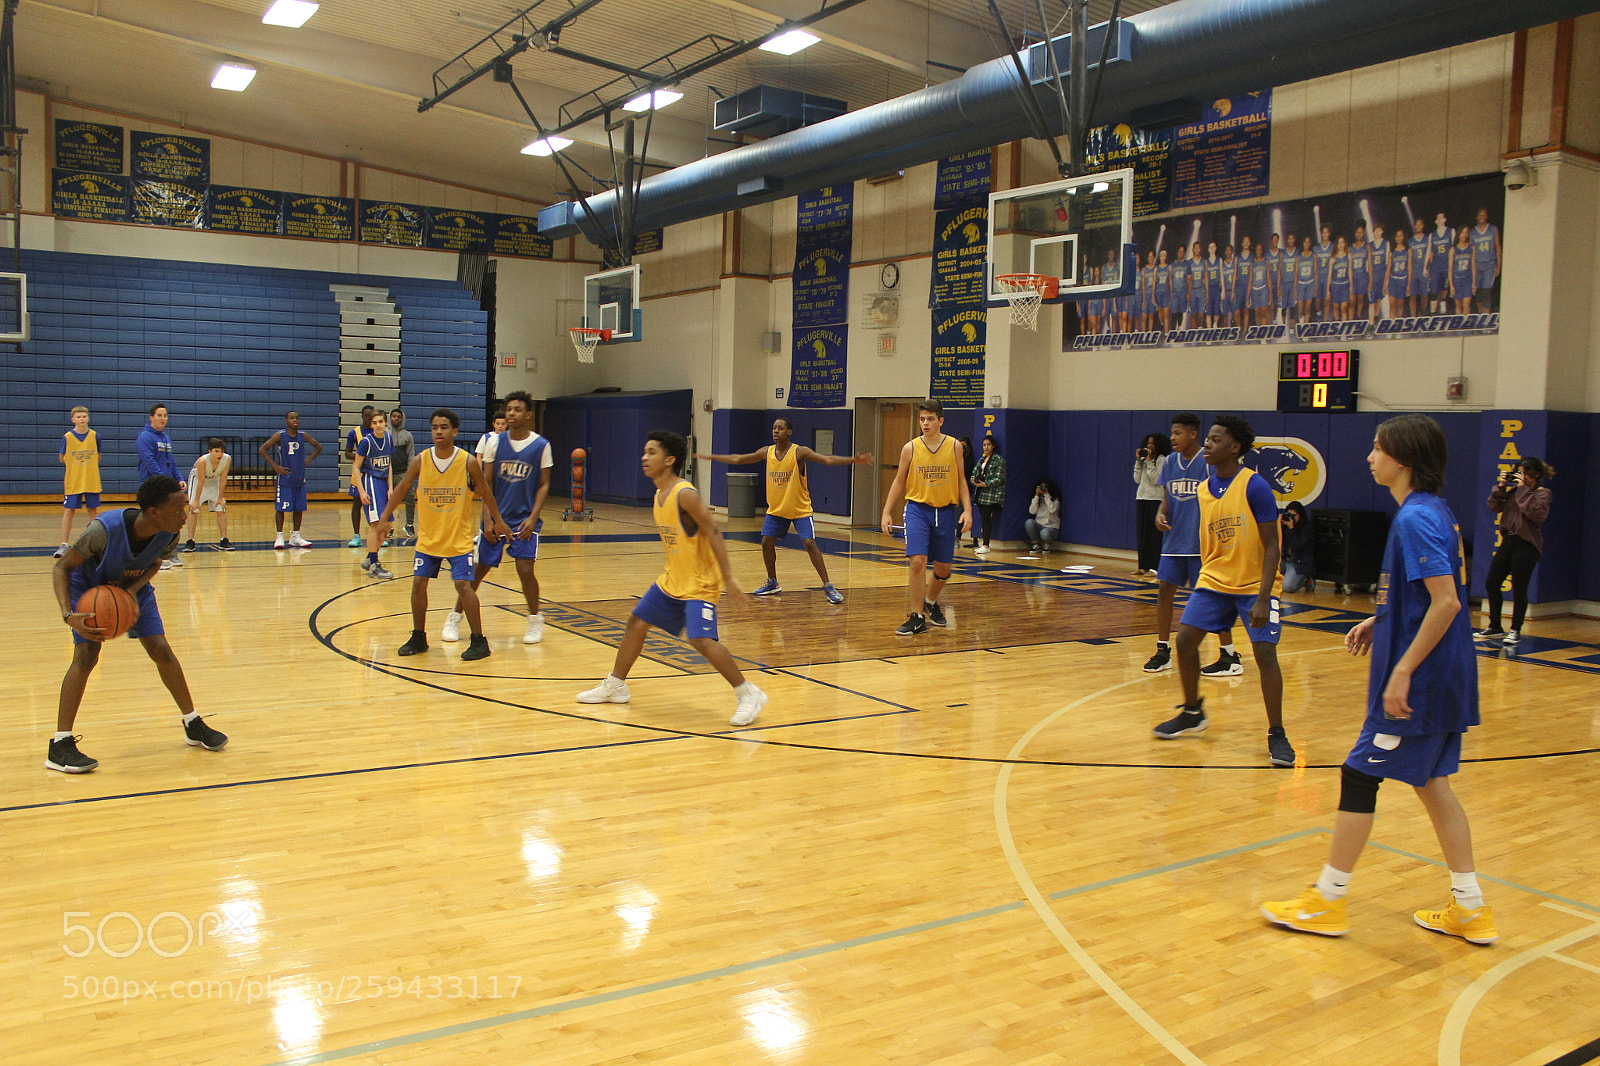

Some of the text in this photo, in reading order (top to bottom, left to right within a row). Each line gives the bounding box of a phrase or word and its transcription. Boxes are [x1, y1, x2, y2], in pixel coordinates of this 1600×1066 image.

[1178, 112, 1267, 137] GIRLS BASKETBALL
[1244, 124, 1268, 132] RECORD
[59, 124, 120, 144] PFLUGERVILLE
[140, 137, 202, 154] PFLUGERVILLE
[1108, 140, 1169, 160] BASKETBALL
[949, 146, 991, 162] GIRLS BASKETB
[1142, 153, 1168, 163] RECORD
[58, 174, 122, 192] PFLUGERVILLE
[942, 182, 960, 192] STATE
[80, 194, 124, 204] BASKETBALL
[217, 190, 276, 206] PFLUGERVILLE
[292, 197, 348, 212] PFLUGERVILLE
[434, 211, 486, 225] PFLUGERVILLE
[941, 207, 989, 242] PFLUGERV
[938, 245, 987, 259] GIRLS BASKET
[1417, 249, 1422, 258] 3
[1438, 244, 1446, 254] 15
[1479, 242, 1490, 252] 44
[798, 248, 844, 270] PFLUGERVILLE
[938, 260, 957, 268] DISTRICT
[1458, 260, 1469, 270] 12
[815, 300, 835, 308] FINALIST
[938, 310, 988, 334] PFLUGERVI
[1074, 312, 1500, 348] PFLUGERVILLE PANTHERS 2018 VARSITY BASKETBALL
[796, 330, 842, 350] PFLUGERVILLE
[935, 346, 956, 355] GIRLS
[504, 357, 514, 366] EXIT
[1312, 383, 1328, 408] 0
[288, 442, 300, 454] P
[501, 462, 530, 478] PVILLE
[423, 487, 462, 496] PFLUGERVILLE
[428, 496, 456, 504] PANTHERS
[414, 558, 424, 570] P
